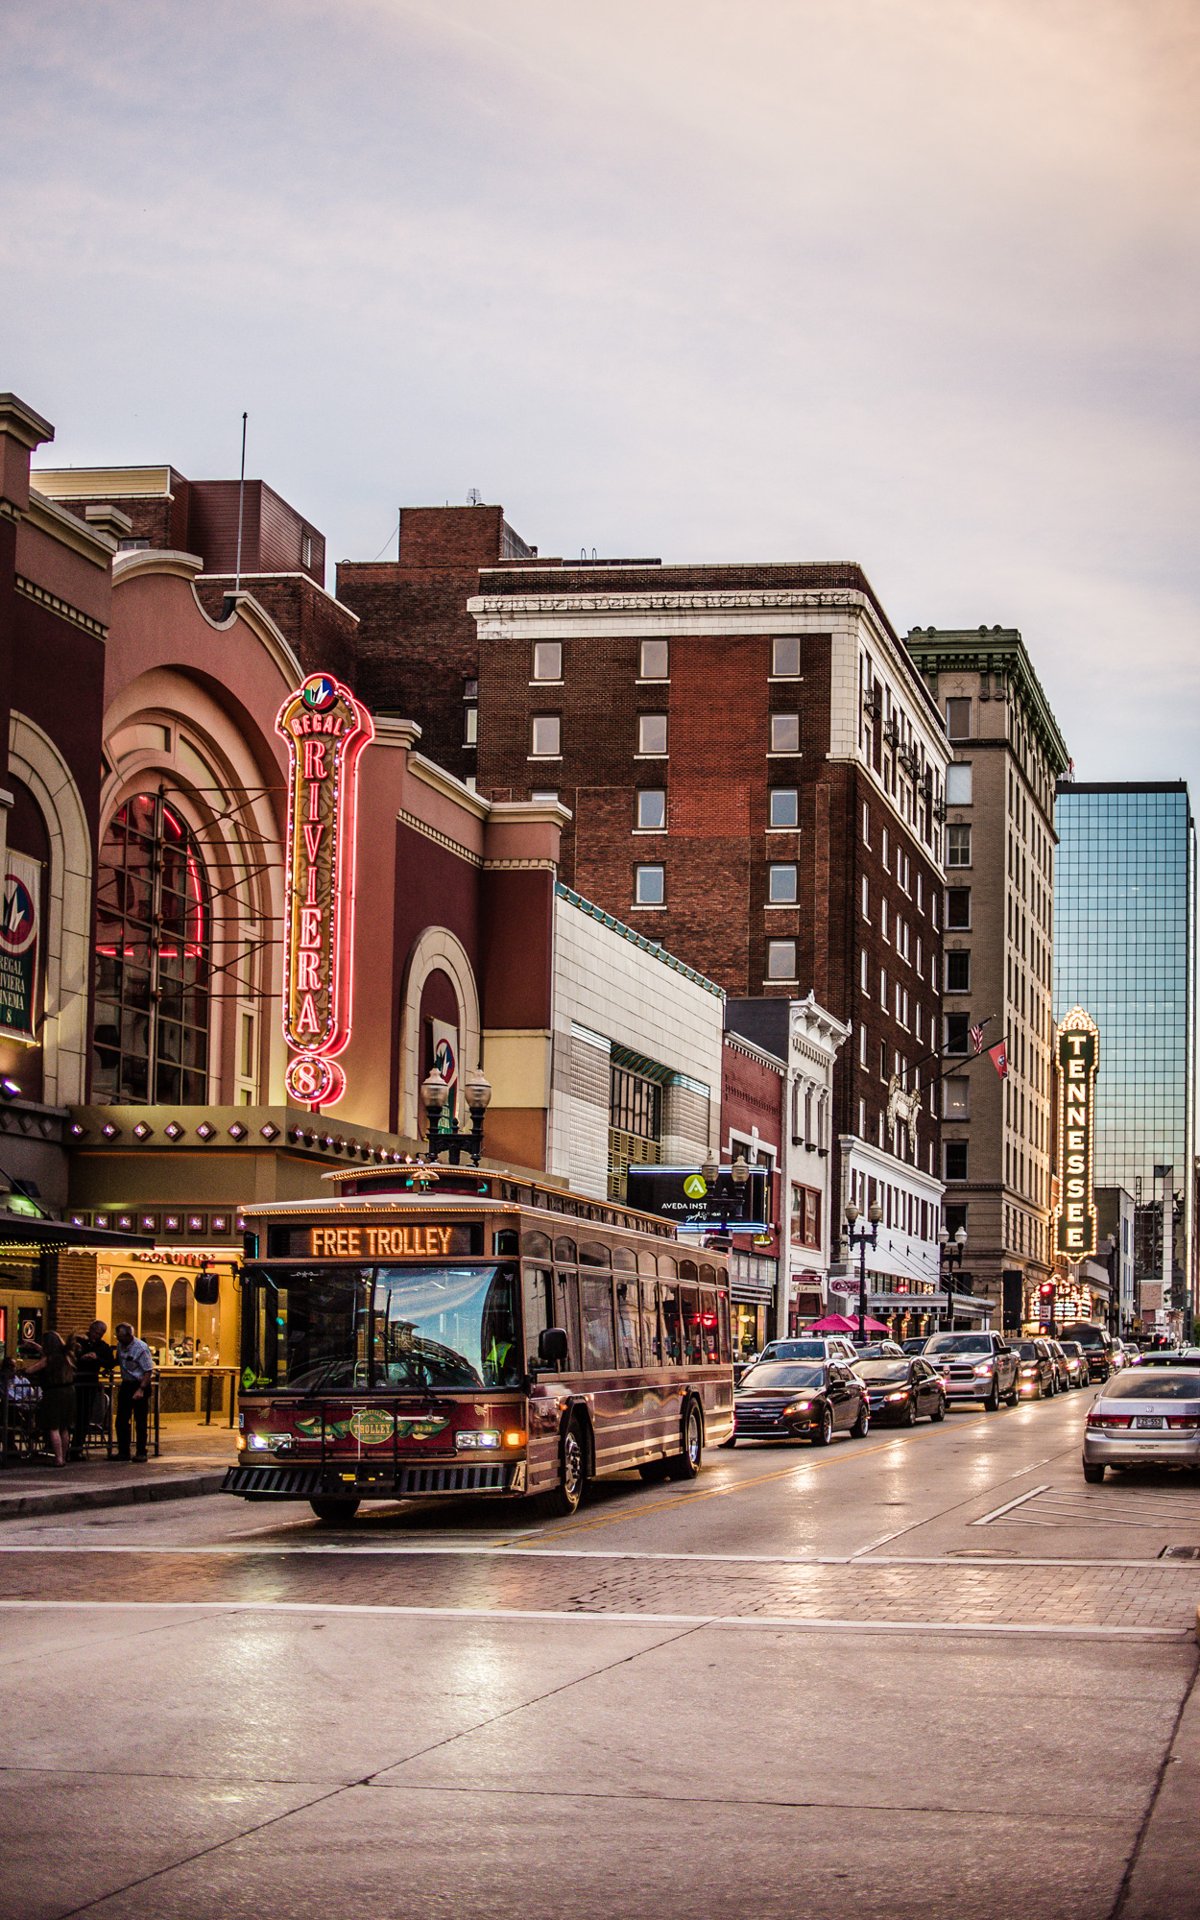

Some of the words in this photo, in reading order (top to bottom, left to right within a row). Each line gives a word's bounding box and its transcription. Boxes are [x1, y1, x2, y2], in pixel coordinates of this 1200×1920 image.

[291, 713, 342, 736] REGAL
[296, 740, 327, 1033] RIVIERA
[298, 1063, 317, 1093] 8
[1066, 1035, 1087, 1248] TENNESSEE
[661, 1202, 688, 1210] AVEDA
[311, 1227, 361, 1256] FREE
[365, 1226, 452, 1256] TROLLEY
[353, 1423, 391, 1434] TROLLEY
